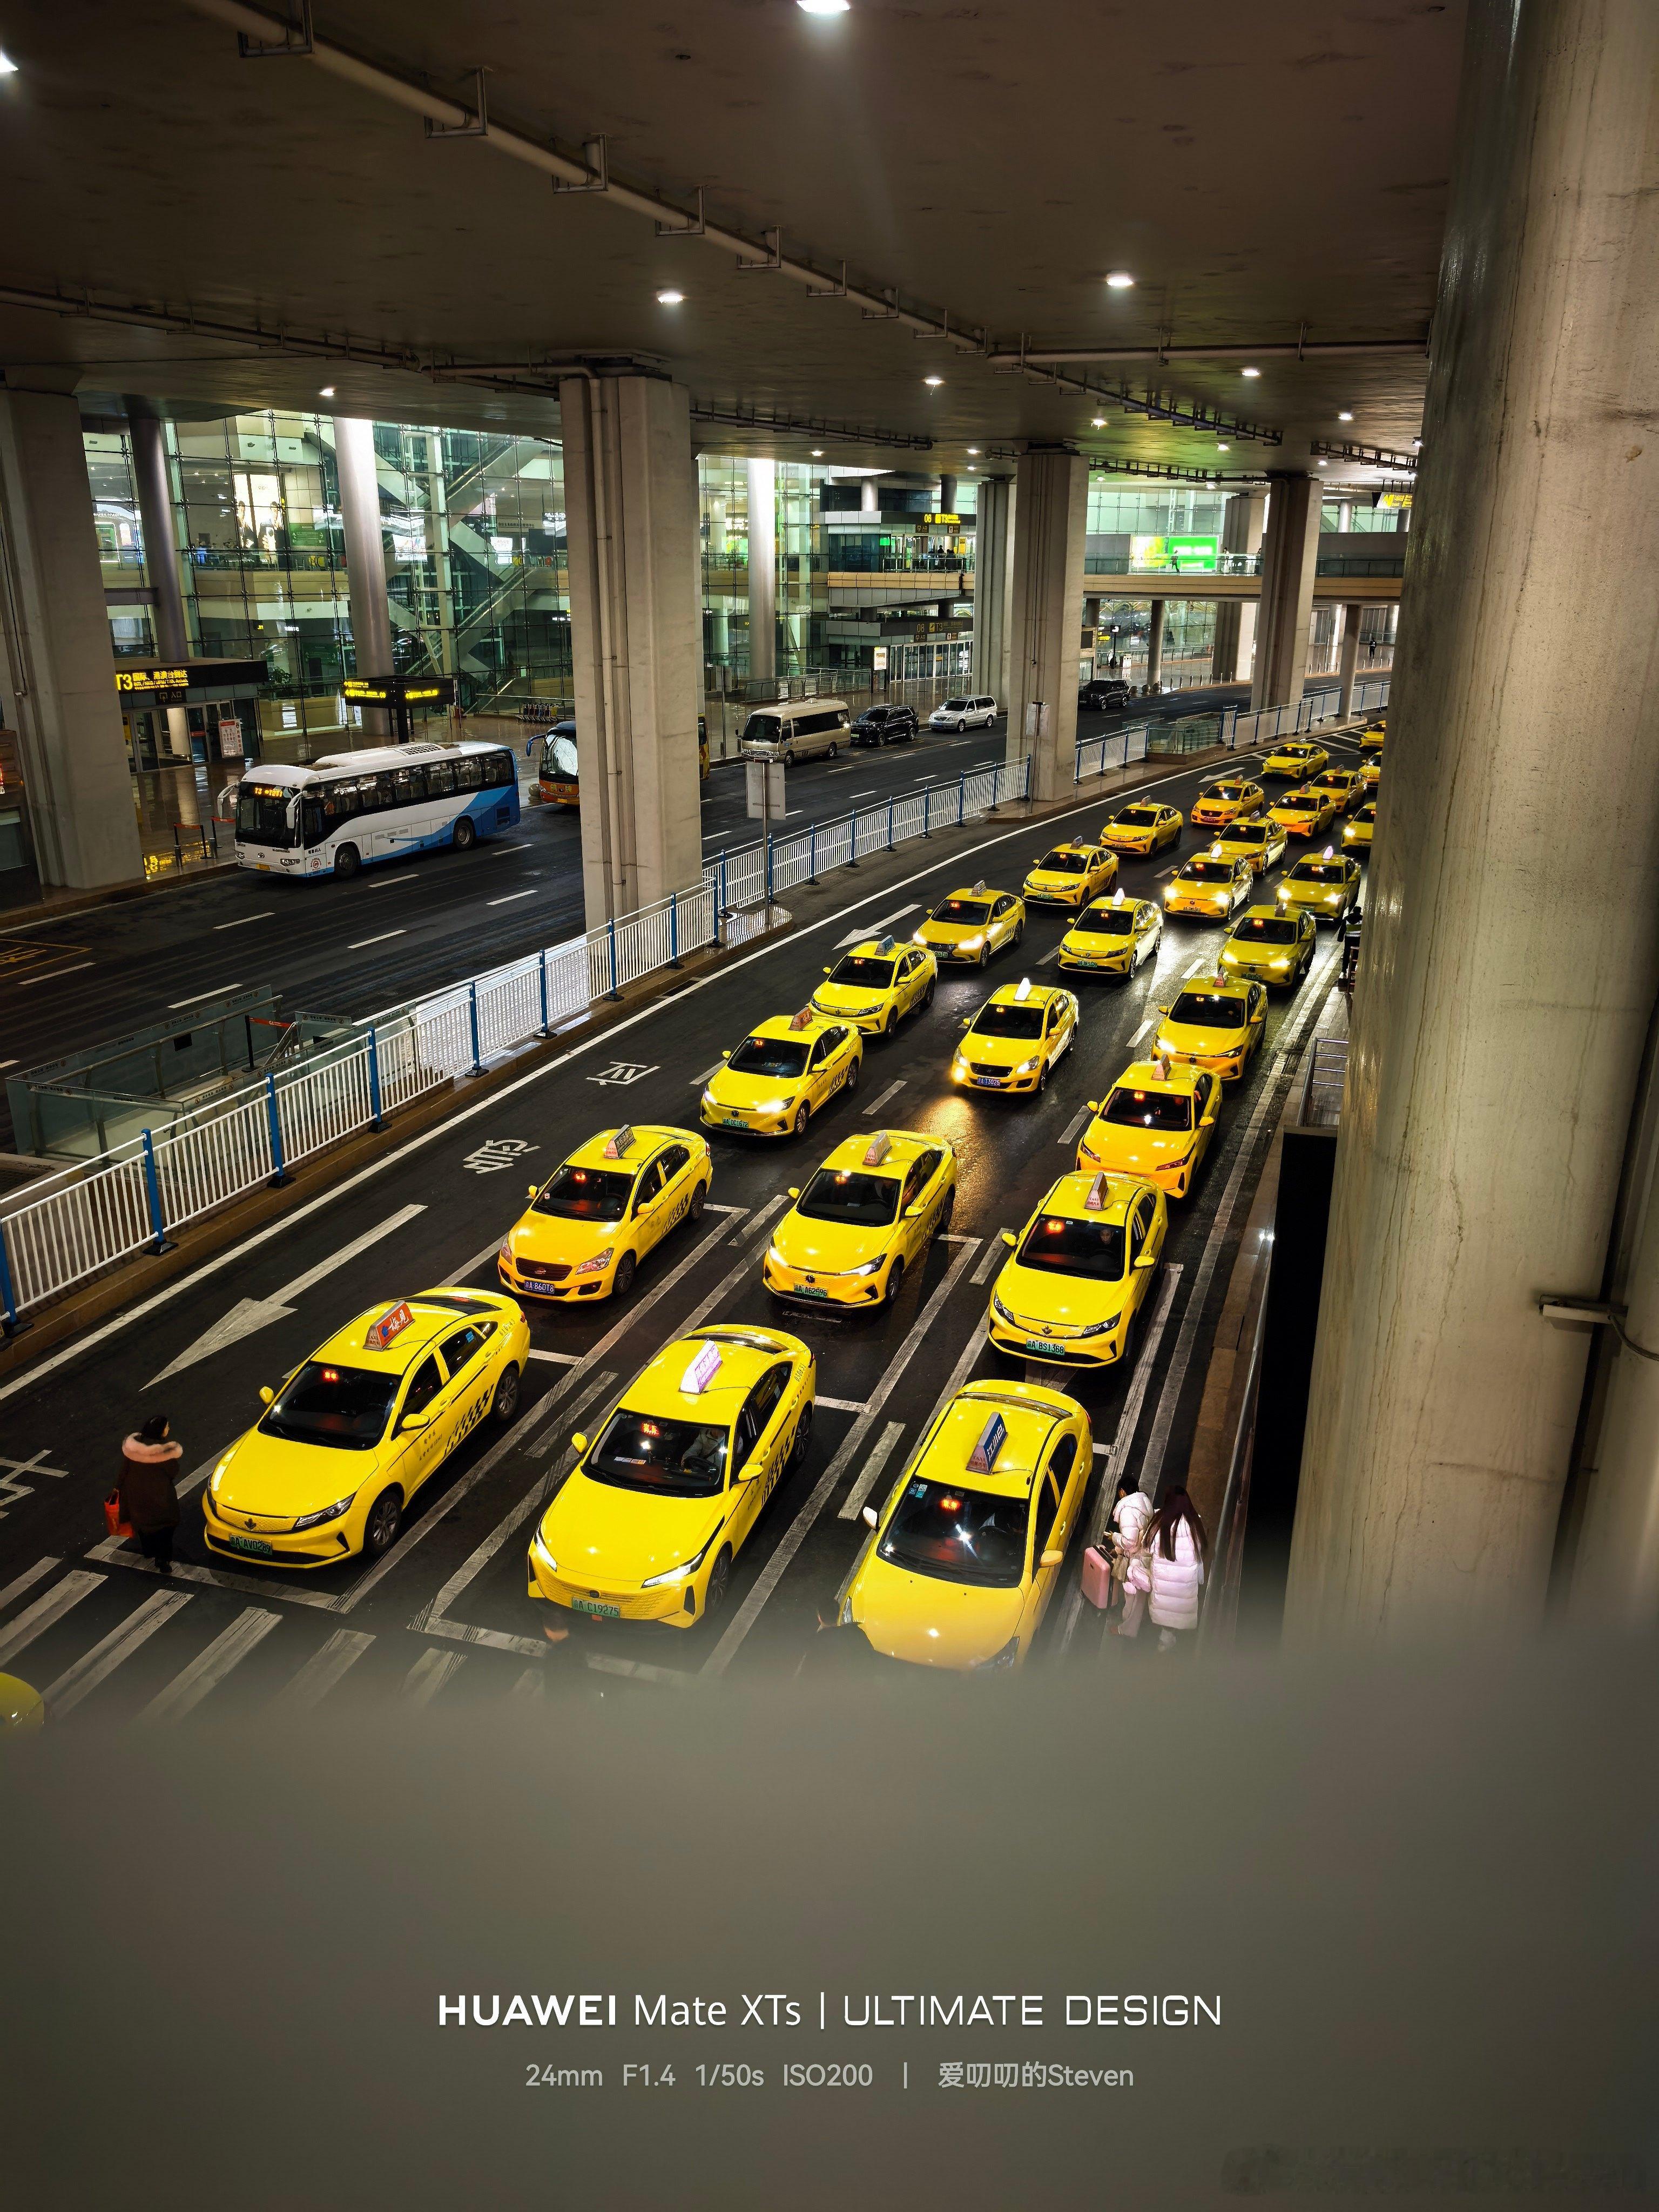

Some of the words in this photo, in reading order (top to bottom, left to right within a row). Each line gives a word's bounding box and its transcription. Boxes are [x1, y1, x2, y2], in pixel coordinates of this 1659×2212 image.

[917, 623, 925, 632] 08
[935, 622, 943, 631] T3
[116, 674, 133, 691] T3
[574, 1599, 619, 1616] AC19275
